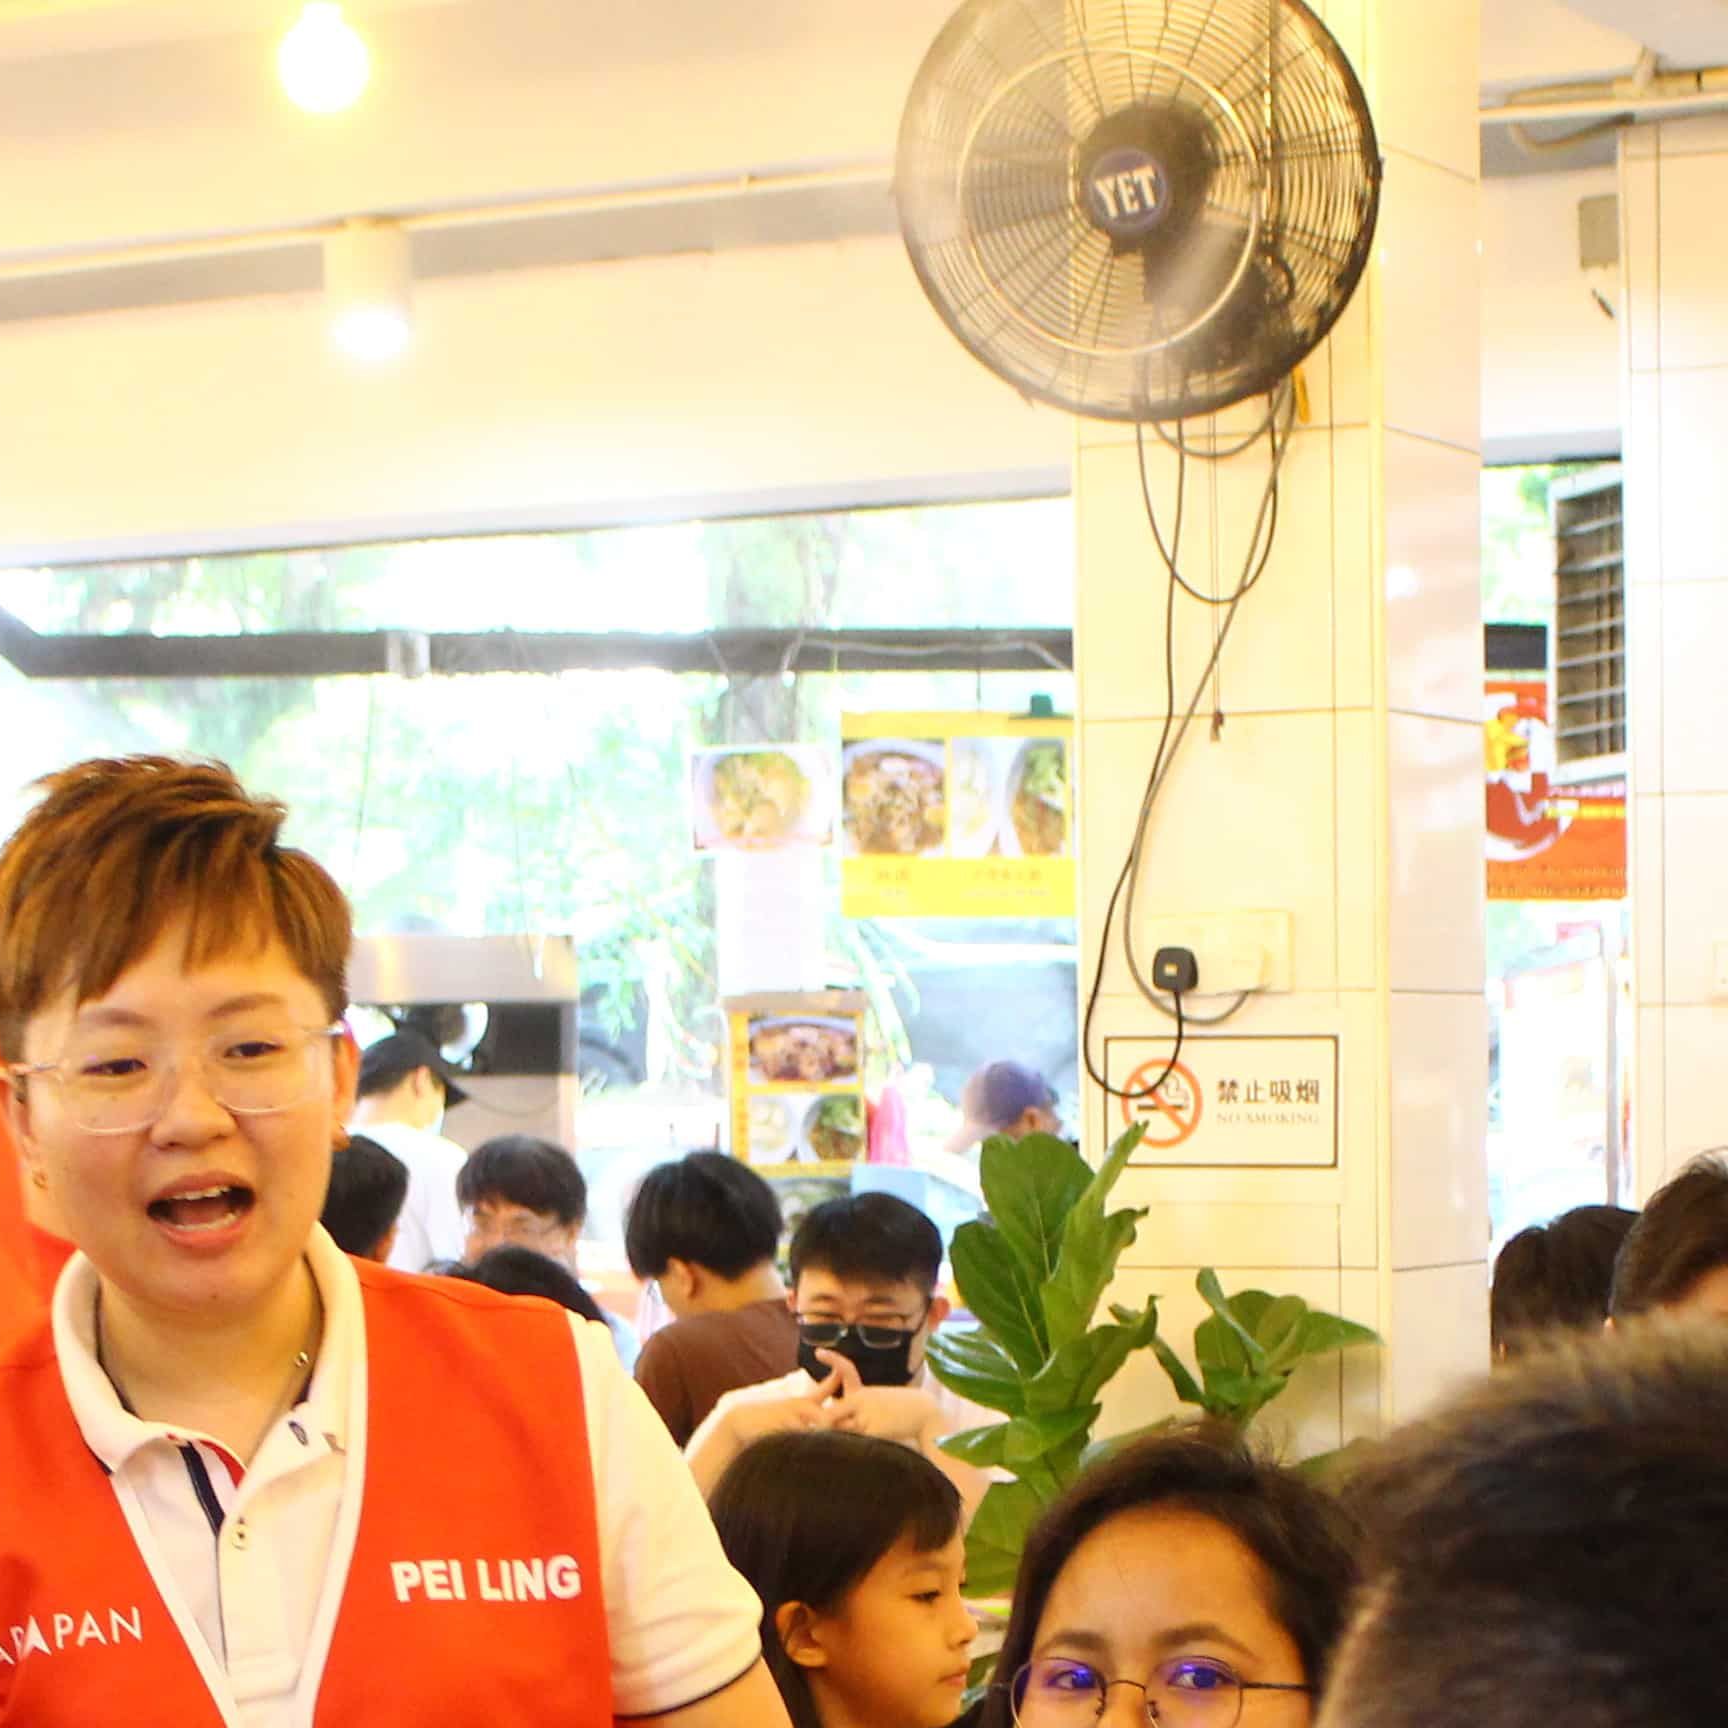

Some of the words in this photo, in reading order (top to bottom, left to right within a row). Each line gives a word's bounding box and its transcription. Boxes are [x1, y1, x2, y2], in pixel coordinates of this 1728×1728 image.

[1095, 169, 1157, 219] YET
[1217, 1078, 1320, 1105] 禁止吸烟
[1246, 1112, 1320, 1125] SMOKING
[389, 1558, 466, 1603] PEI
[477, 1554, 583, 1600] LING
